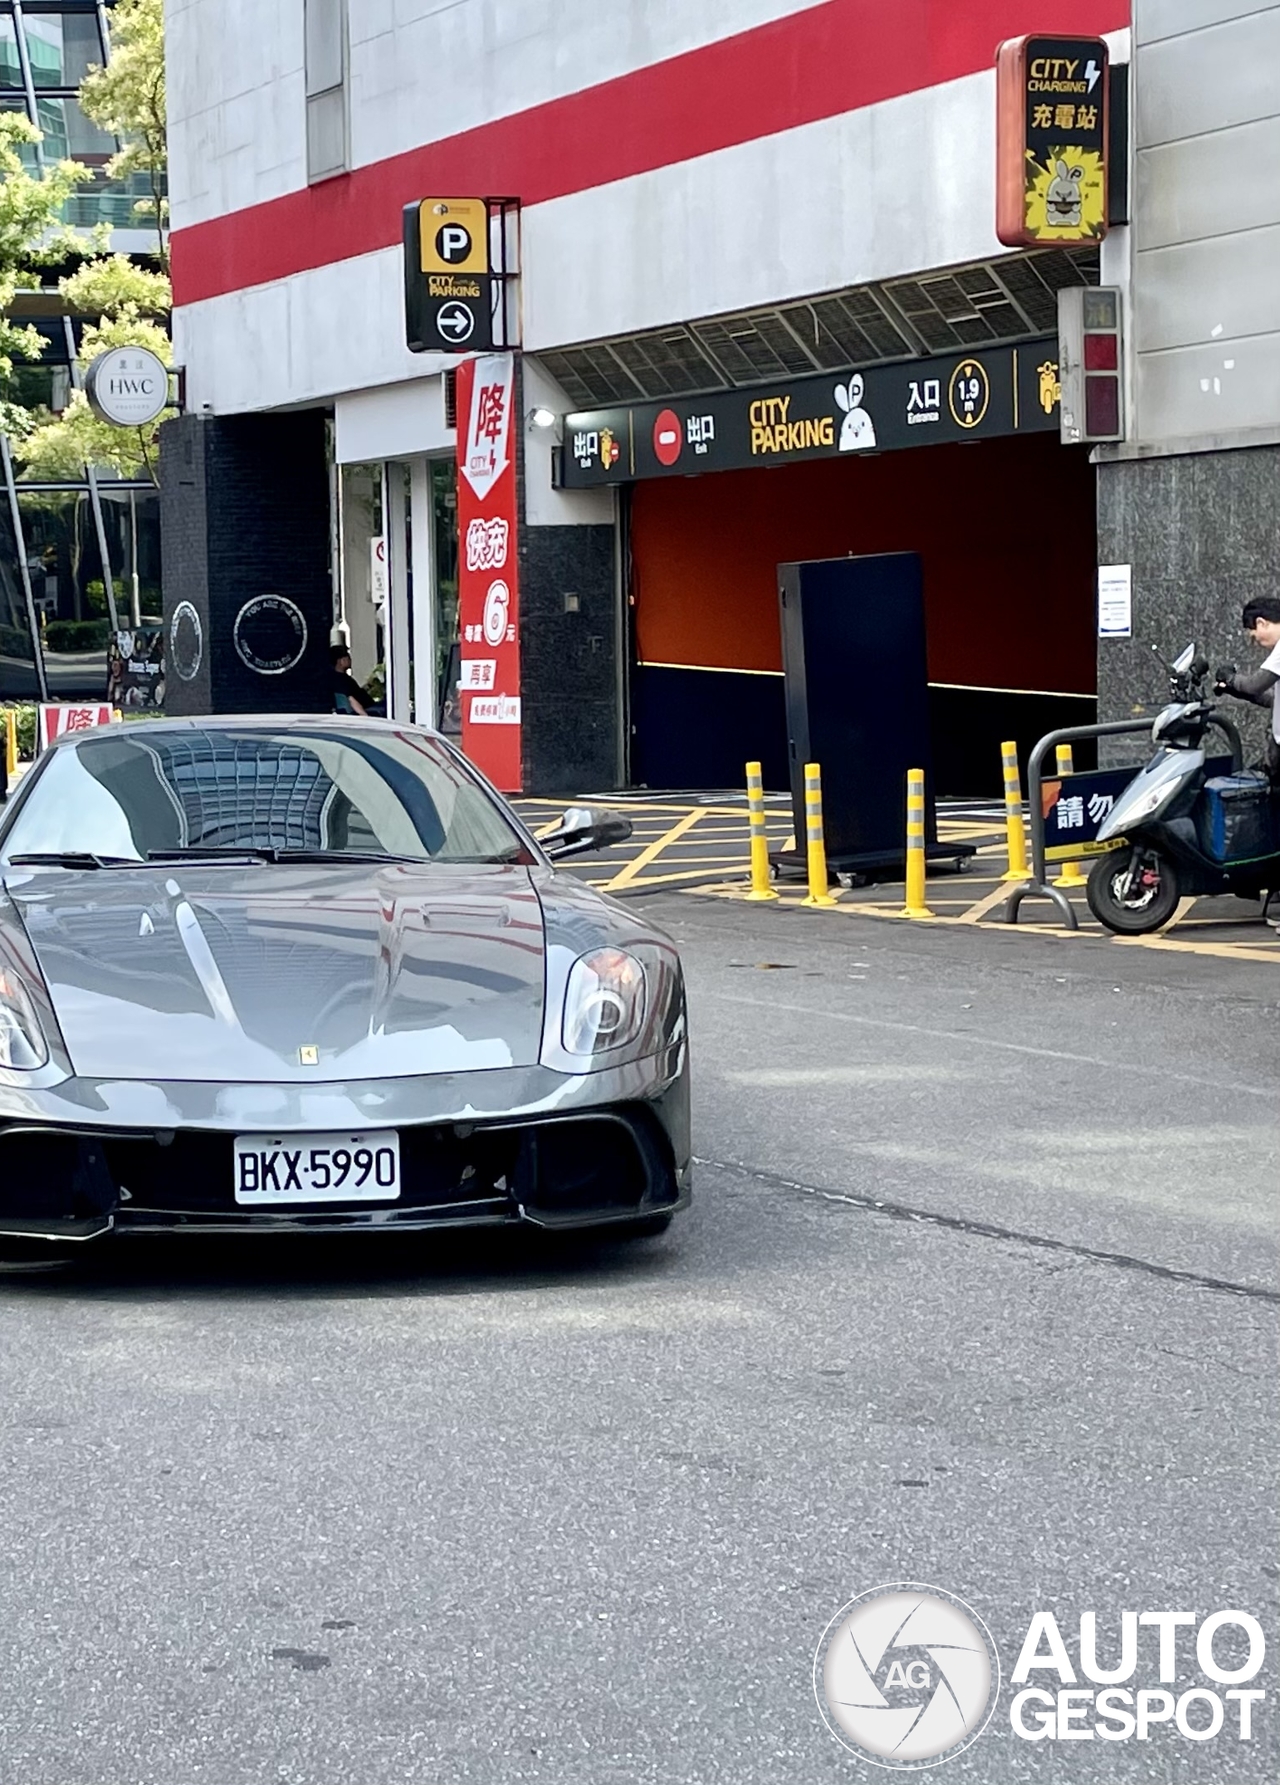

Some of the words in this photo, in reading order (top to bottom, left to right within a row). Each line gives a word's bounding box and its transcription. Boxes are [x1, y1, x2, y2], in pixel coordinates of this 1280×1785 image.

[1030, 59, 1079, 79] CITY
[1028, 80, 1087, 93] CHARGING
[1031, 103, 1098, 130] 充電站
[443, 228, 468, 259] P
[429, 276, 454, 286] CITY
[429, 286, 480, 297] PARKING
[110, 379, 153, 394] HWC
[852, 384, 860, 399] P
[907, 379, 940, 411] 入口
[958, 379, 979, 400] 1.9
[475, 383, 504, 447] 降
[750, 396, 790, 427] CITY
[964, 401, 974, 411] m
[687, 415, 714, 444] 出口
[751, 417, 834, 455] PARKING
[574, 432, 598, 458] 出口
[468, 519, 507, 569] 快充
[1056, 793, 1114, 829] 請勿
